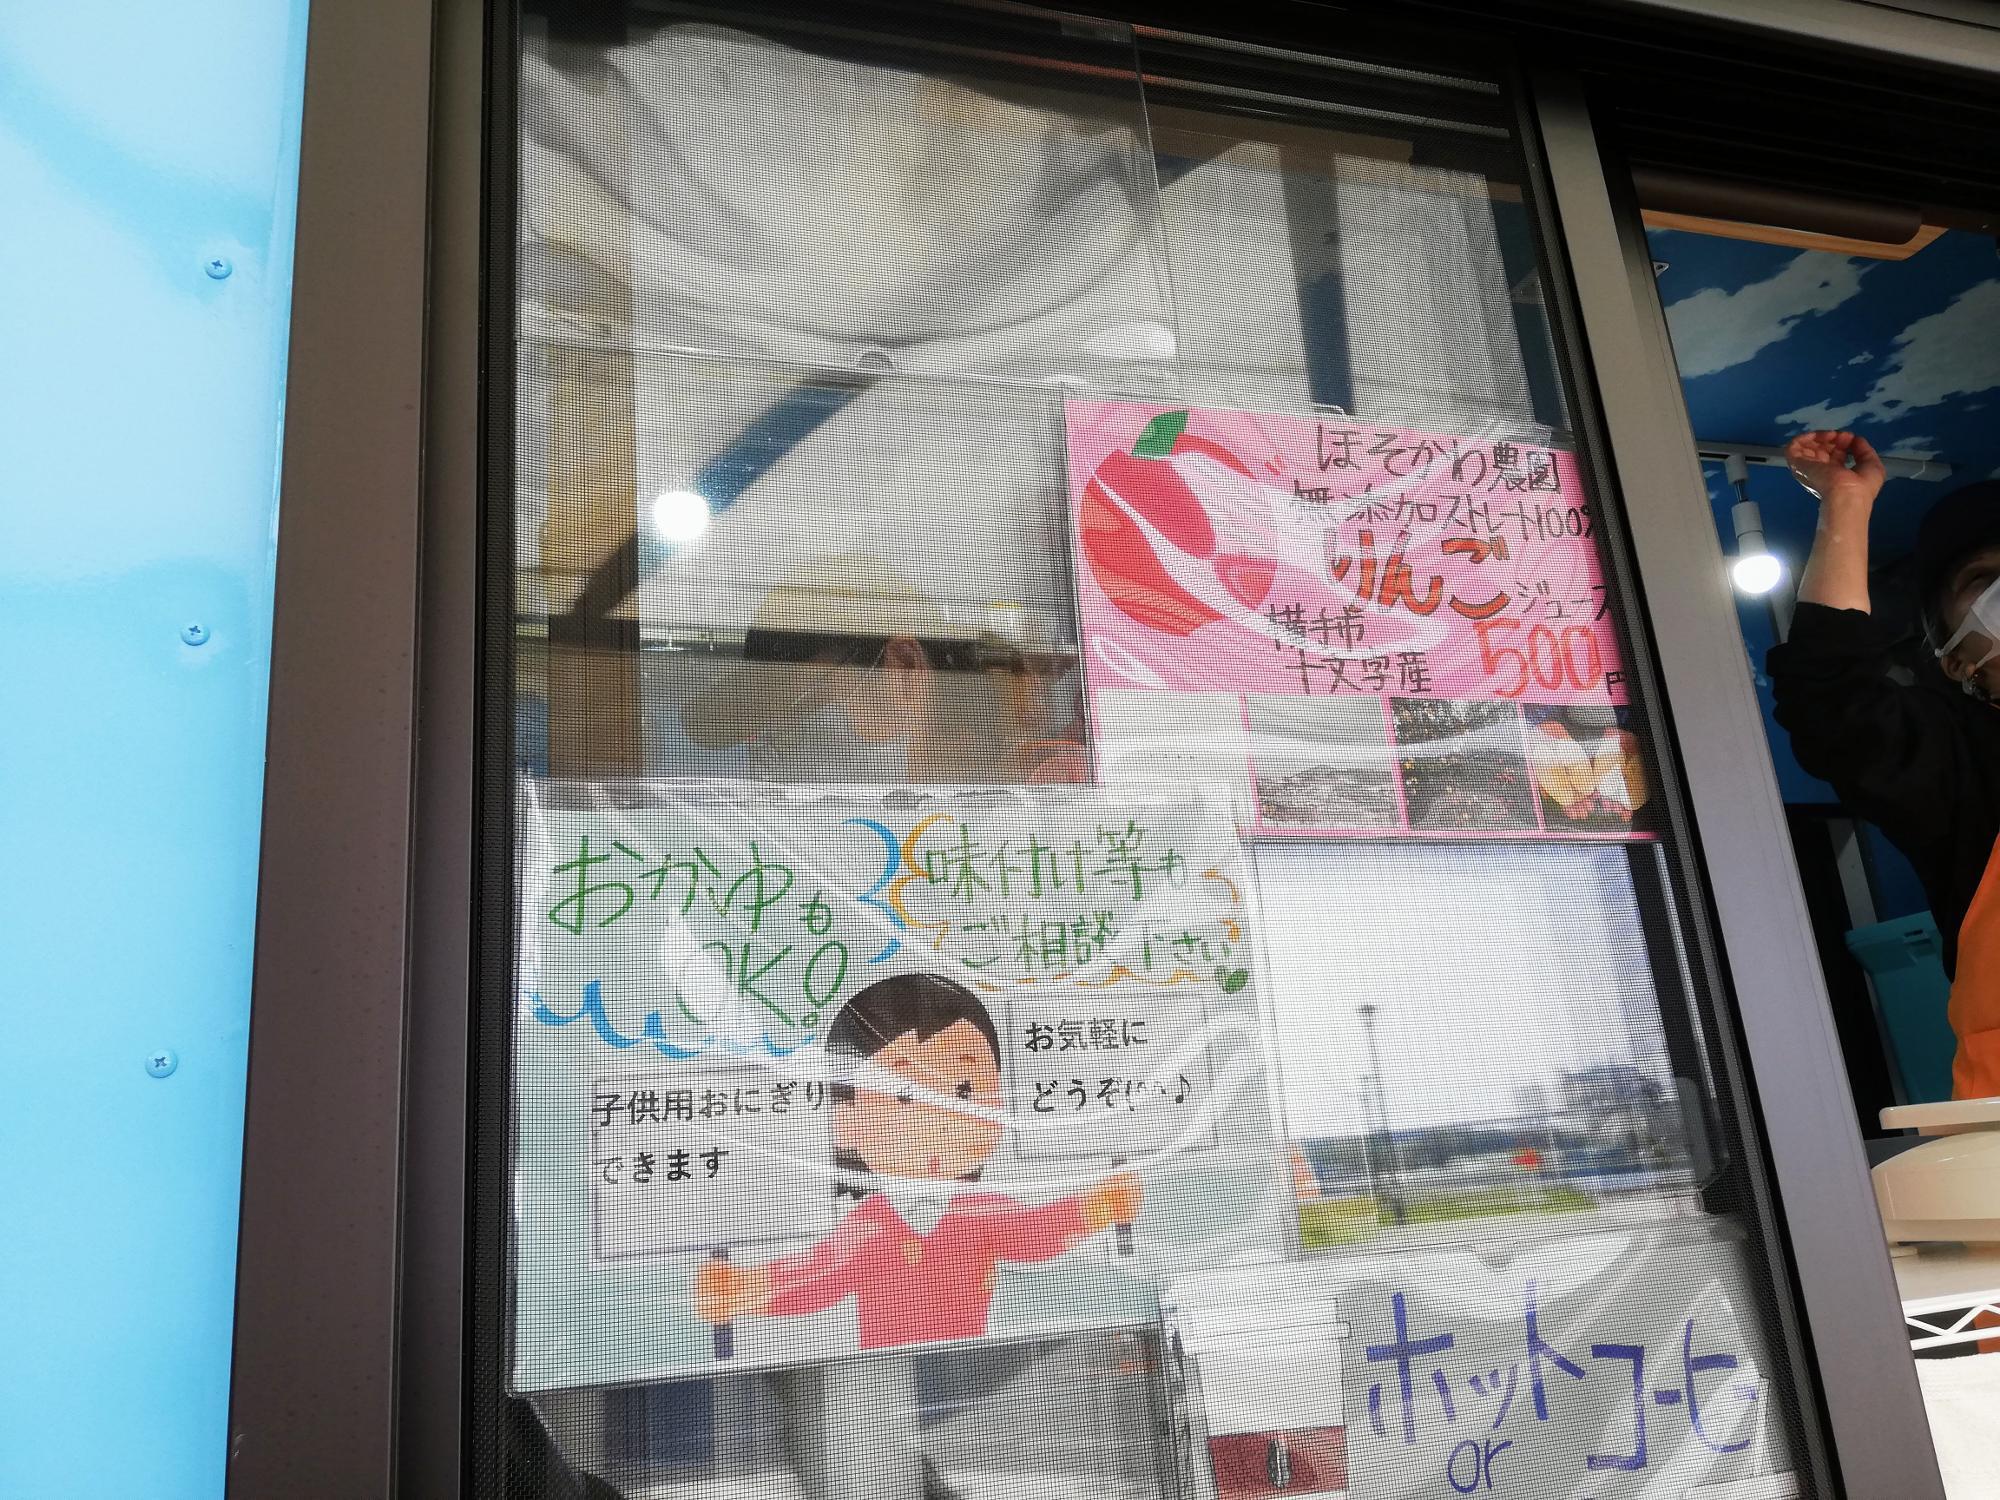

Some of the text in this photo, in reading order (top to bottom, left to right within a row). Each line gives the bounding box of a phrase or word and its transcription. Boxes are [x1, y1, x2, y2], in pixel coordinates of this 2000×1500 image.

[1316, 425, 1563, 494] ほそかわ農園
[1285, 649, 1432, 694] 十文字産
[1024, 1018, 1149, 1052] お気軽に
[591, 1081, 825, 1126] 子供用おにぎり
[594, 1146, 730, 1184] できます
[1448, 1439, 1512, 1493] or
